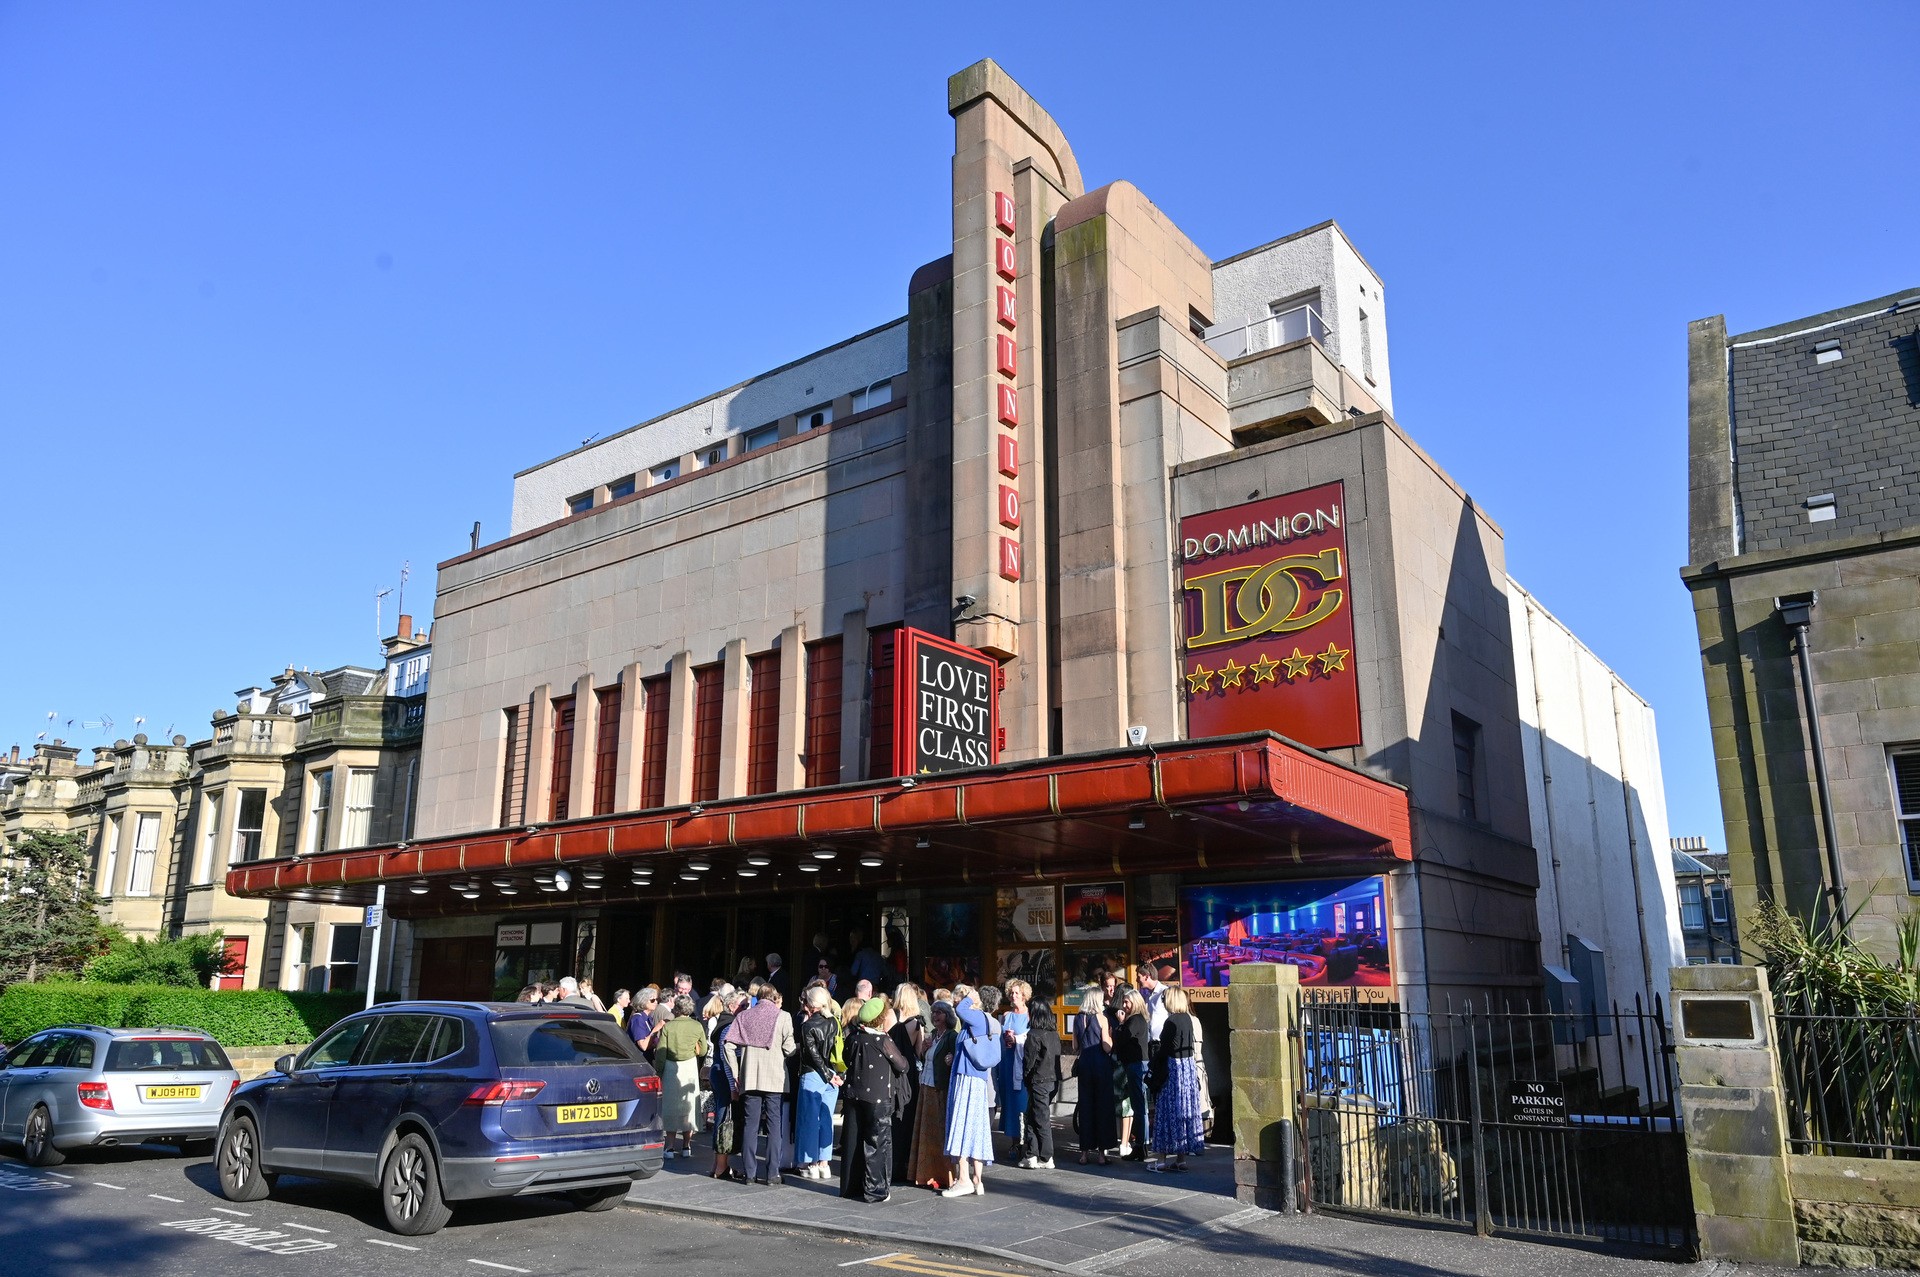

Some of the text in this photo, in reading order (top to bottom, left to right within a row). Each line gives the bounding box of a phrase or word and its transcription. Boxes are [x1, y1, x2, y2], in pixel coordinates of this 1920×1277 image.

[1003, 197, 1018, 573] DOMINION
[1185, 504, 1339, 558] DOMINION
[1185, 548, 1343, 648] DC
[920, 655, 988, 702] LOVE
[920, 690, 988, 735] FIRST
[919, 727, 988, 767] CLASS
[1028, 910, 1053, 925] SISU
[1189, 989, 1220, 998] Private
[1364, 989, 1384, 998] You
[151, 1088, 196, 1097] WJ09 HTD
[1512, 1095, 1563, 1106] PARKING
[1527, 1084, 1544, 1093] NO
[562, 1106, 613, 1121] BW72 DSO
